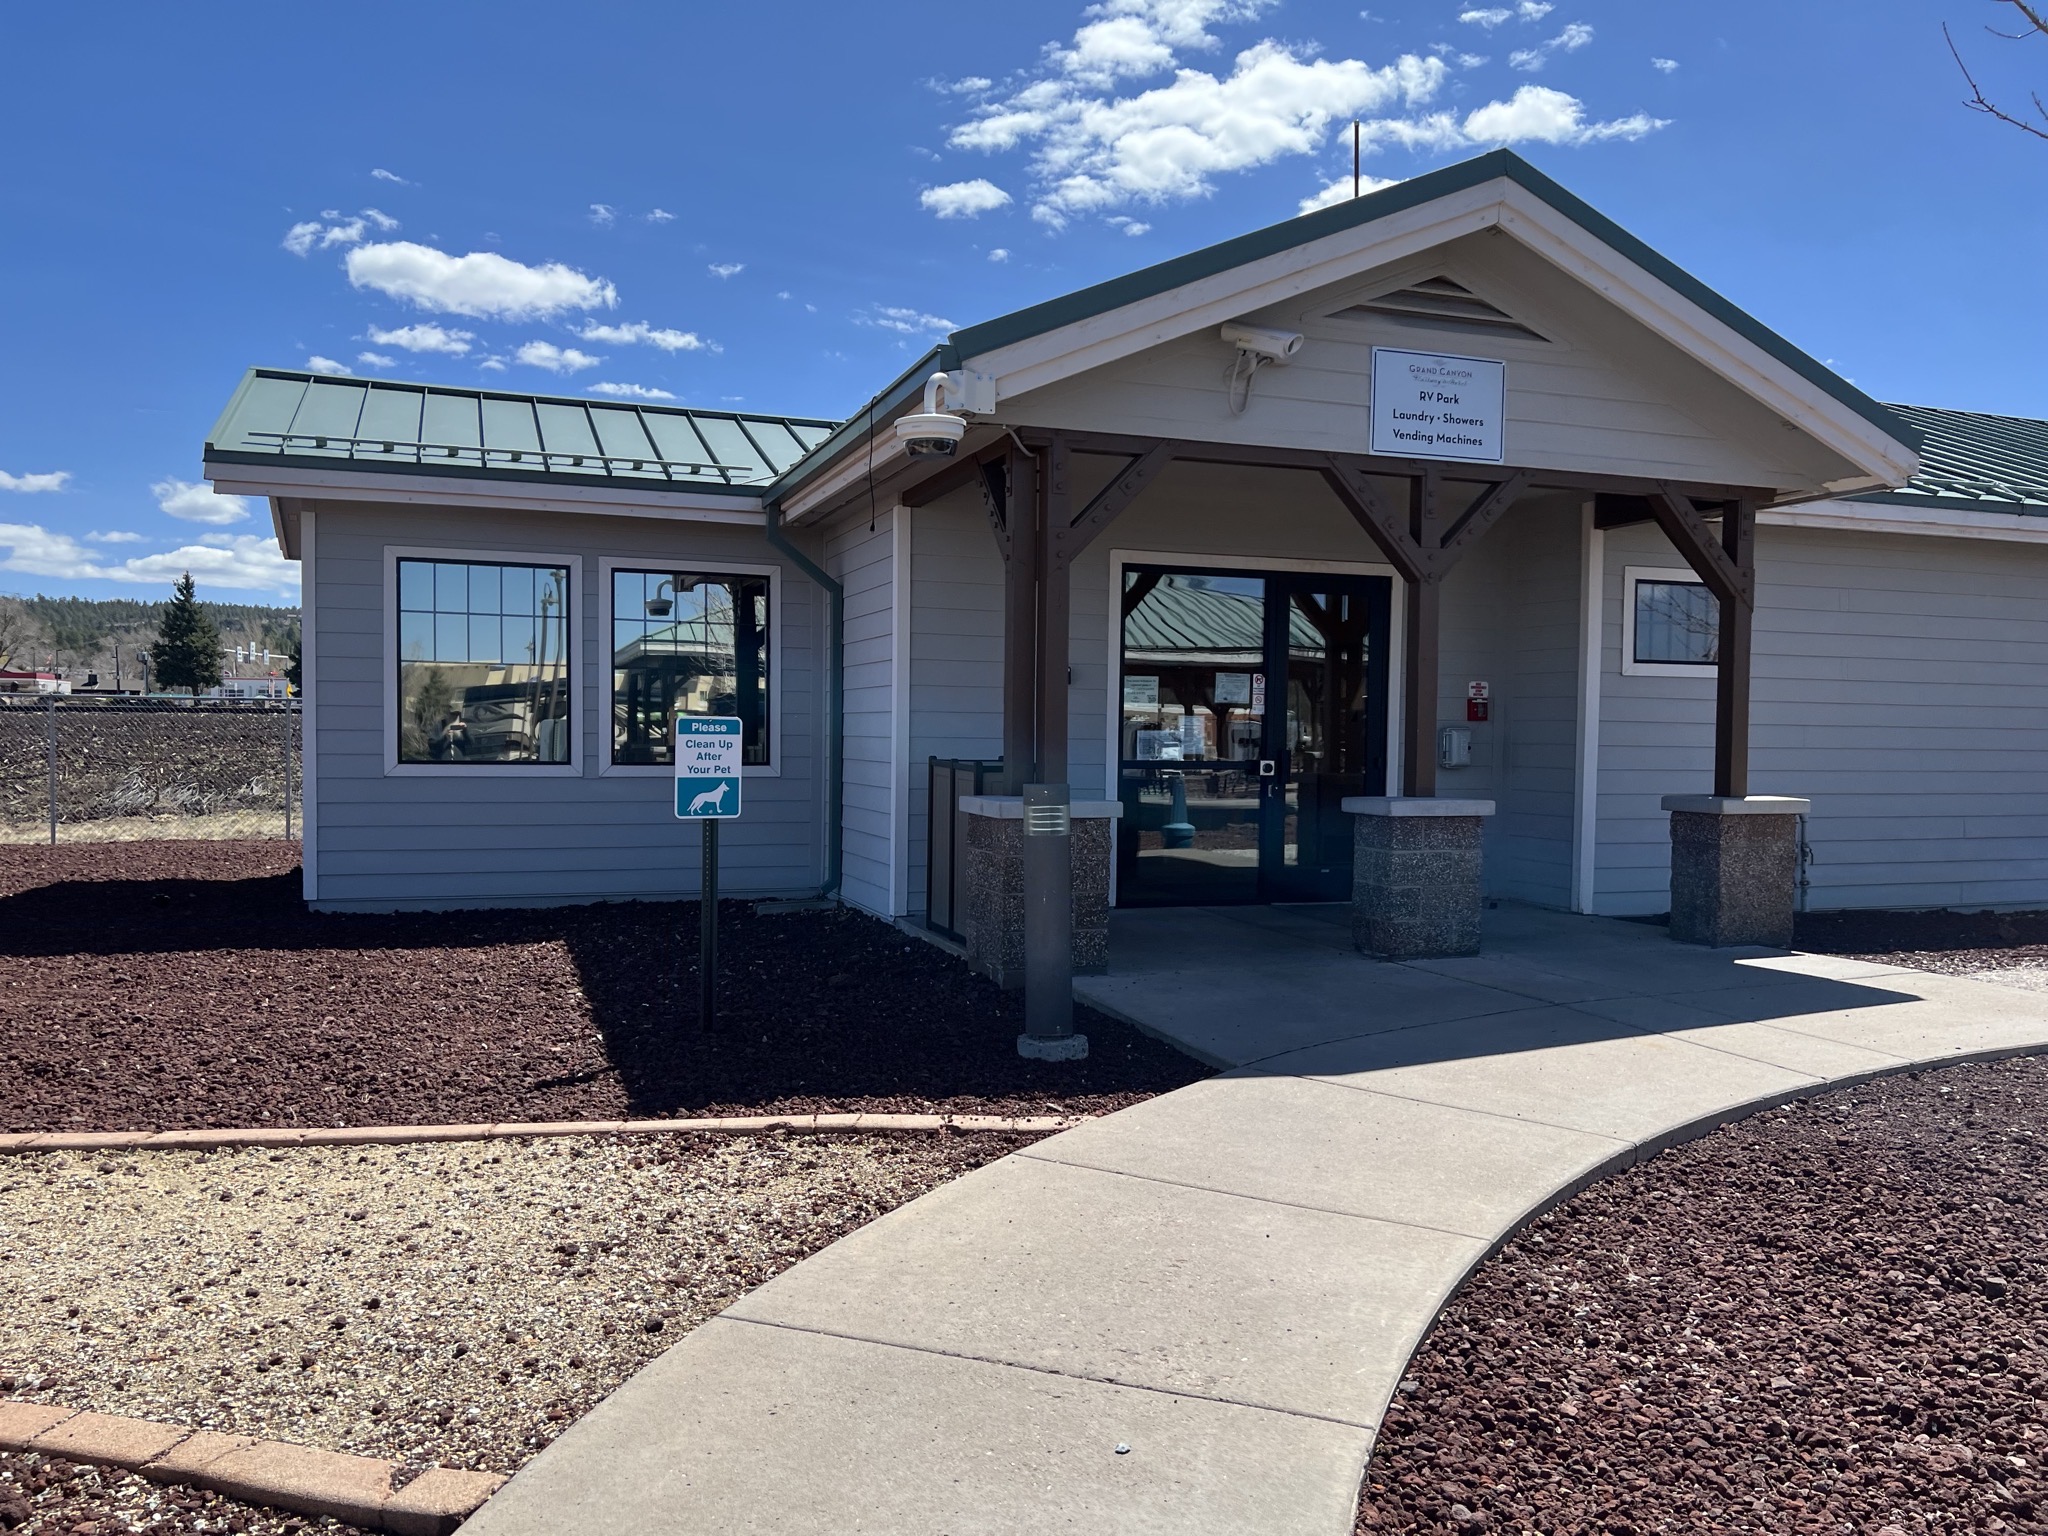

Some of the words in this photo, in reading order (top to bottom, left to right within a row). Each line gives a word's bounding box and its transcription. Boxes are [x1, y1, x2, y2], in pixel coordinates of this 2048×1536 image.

[1409, 364, 1437, 374] GRAND
[1439, 367, 1473, 378] CANYON
[1419, 391, 1434, 401] RV
[1436, 392, 1460, 404] Park
[1392, 408, 1435, 424] Laundry
[1442, 413, 1484, 427] Showers
[1392, 428, 1434, 445] Vending
[1436, 433, 1483, 446] Machines
[691, 722, 728, 732] Please
[685, 739, 715, 749] Clean
[718, 739, 733, 750] Up
[696, 751, 722, 761] After
[687, 765, 711, 774] Your
[714, 765, 731, 774] Pet
